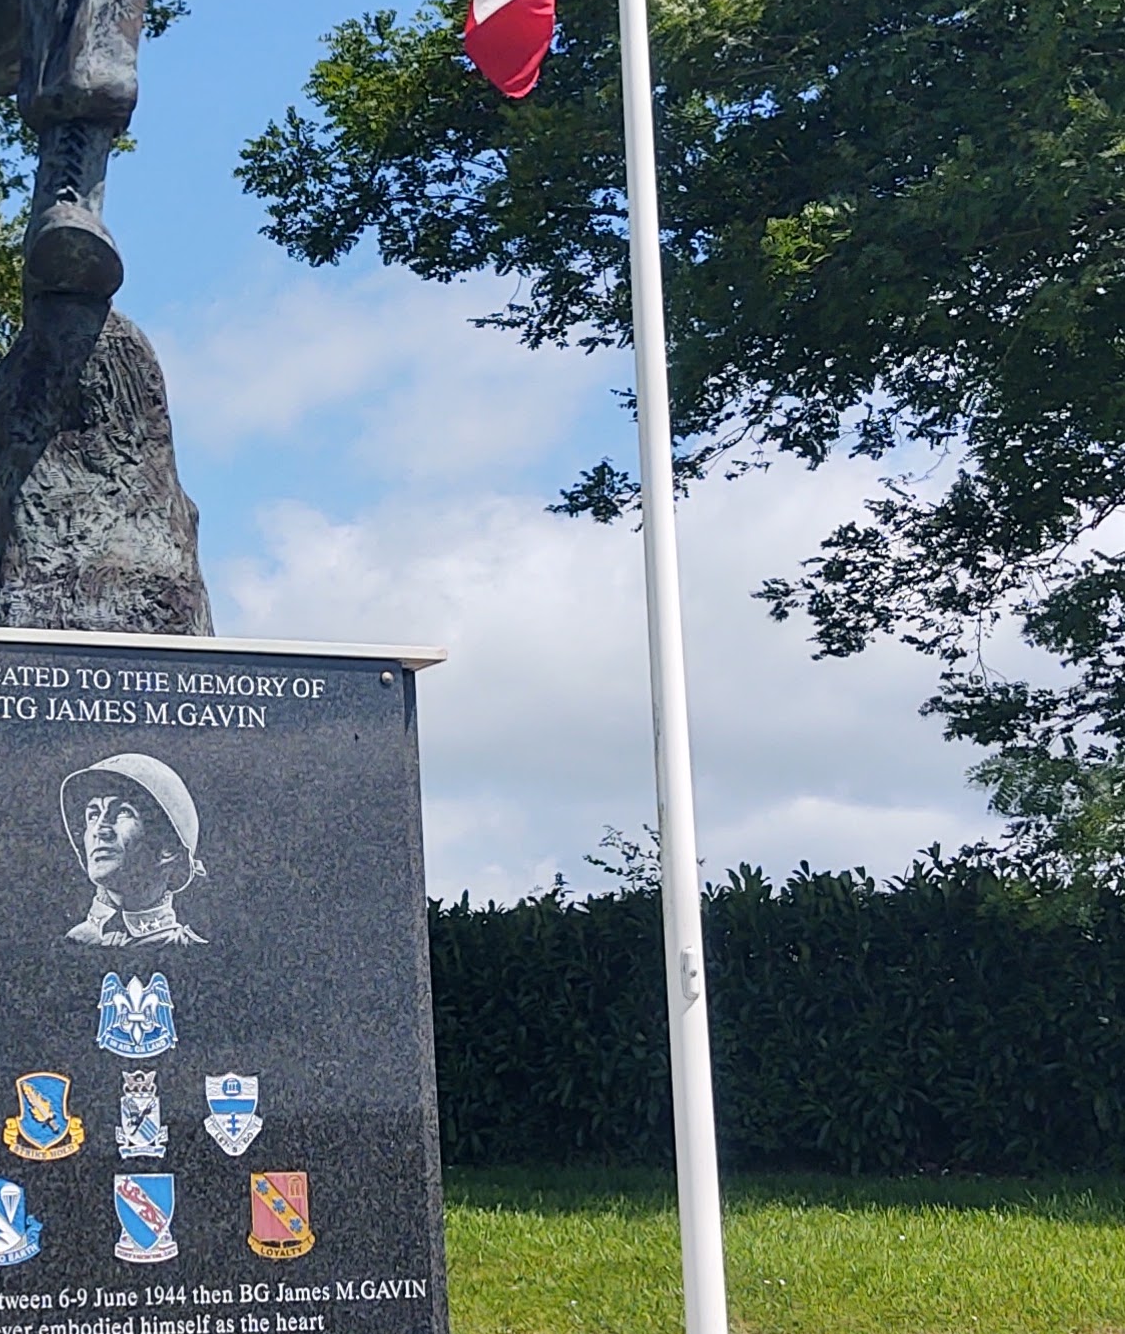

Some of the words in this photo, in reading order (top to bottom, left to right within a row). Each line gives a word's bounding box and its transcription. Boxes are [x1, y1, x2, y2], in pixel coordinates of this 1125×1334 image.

[75, 668, 111, 690] TO
[117, 670, 170, 693] THE
[176, 673, 289, 698] MEMORY
[292, 677, 326, 699] OF
[45, 697, 137, 724] JAMES
[144, 701, 267, 728] M.GAVIN
[260, 1246, 303, 1257] LOYALTY
[58, 1287, 88, 1309] 6-9
[93, 1287, 139, 1308] June
[144, 1284, 187, 1306] 1944
[192, 1284, 234, 1305] then
[238, 1282, 271, 1304] BG
[275, 1282, 331, 1303] James
[335, 1278, 427, 1301] M.GAVIN
[215, 1318, 235, 1334] as
[240, 1313, 270, 1334] the
[275, 1312, 325, 1332] heart
